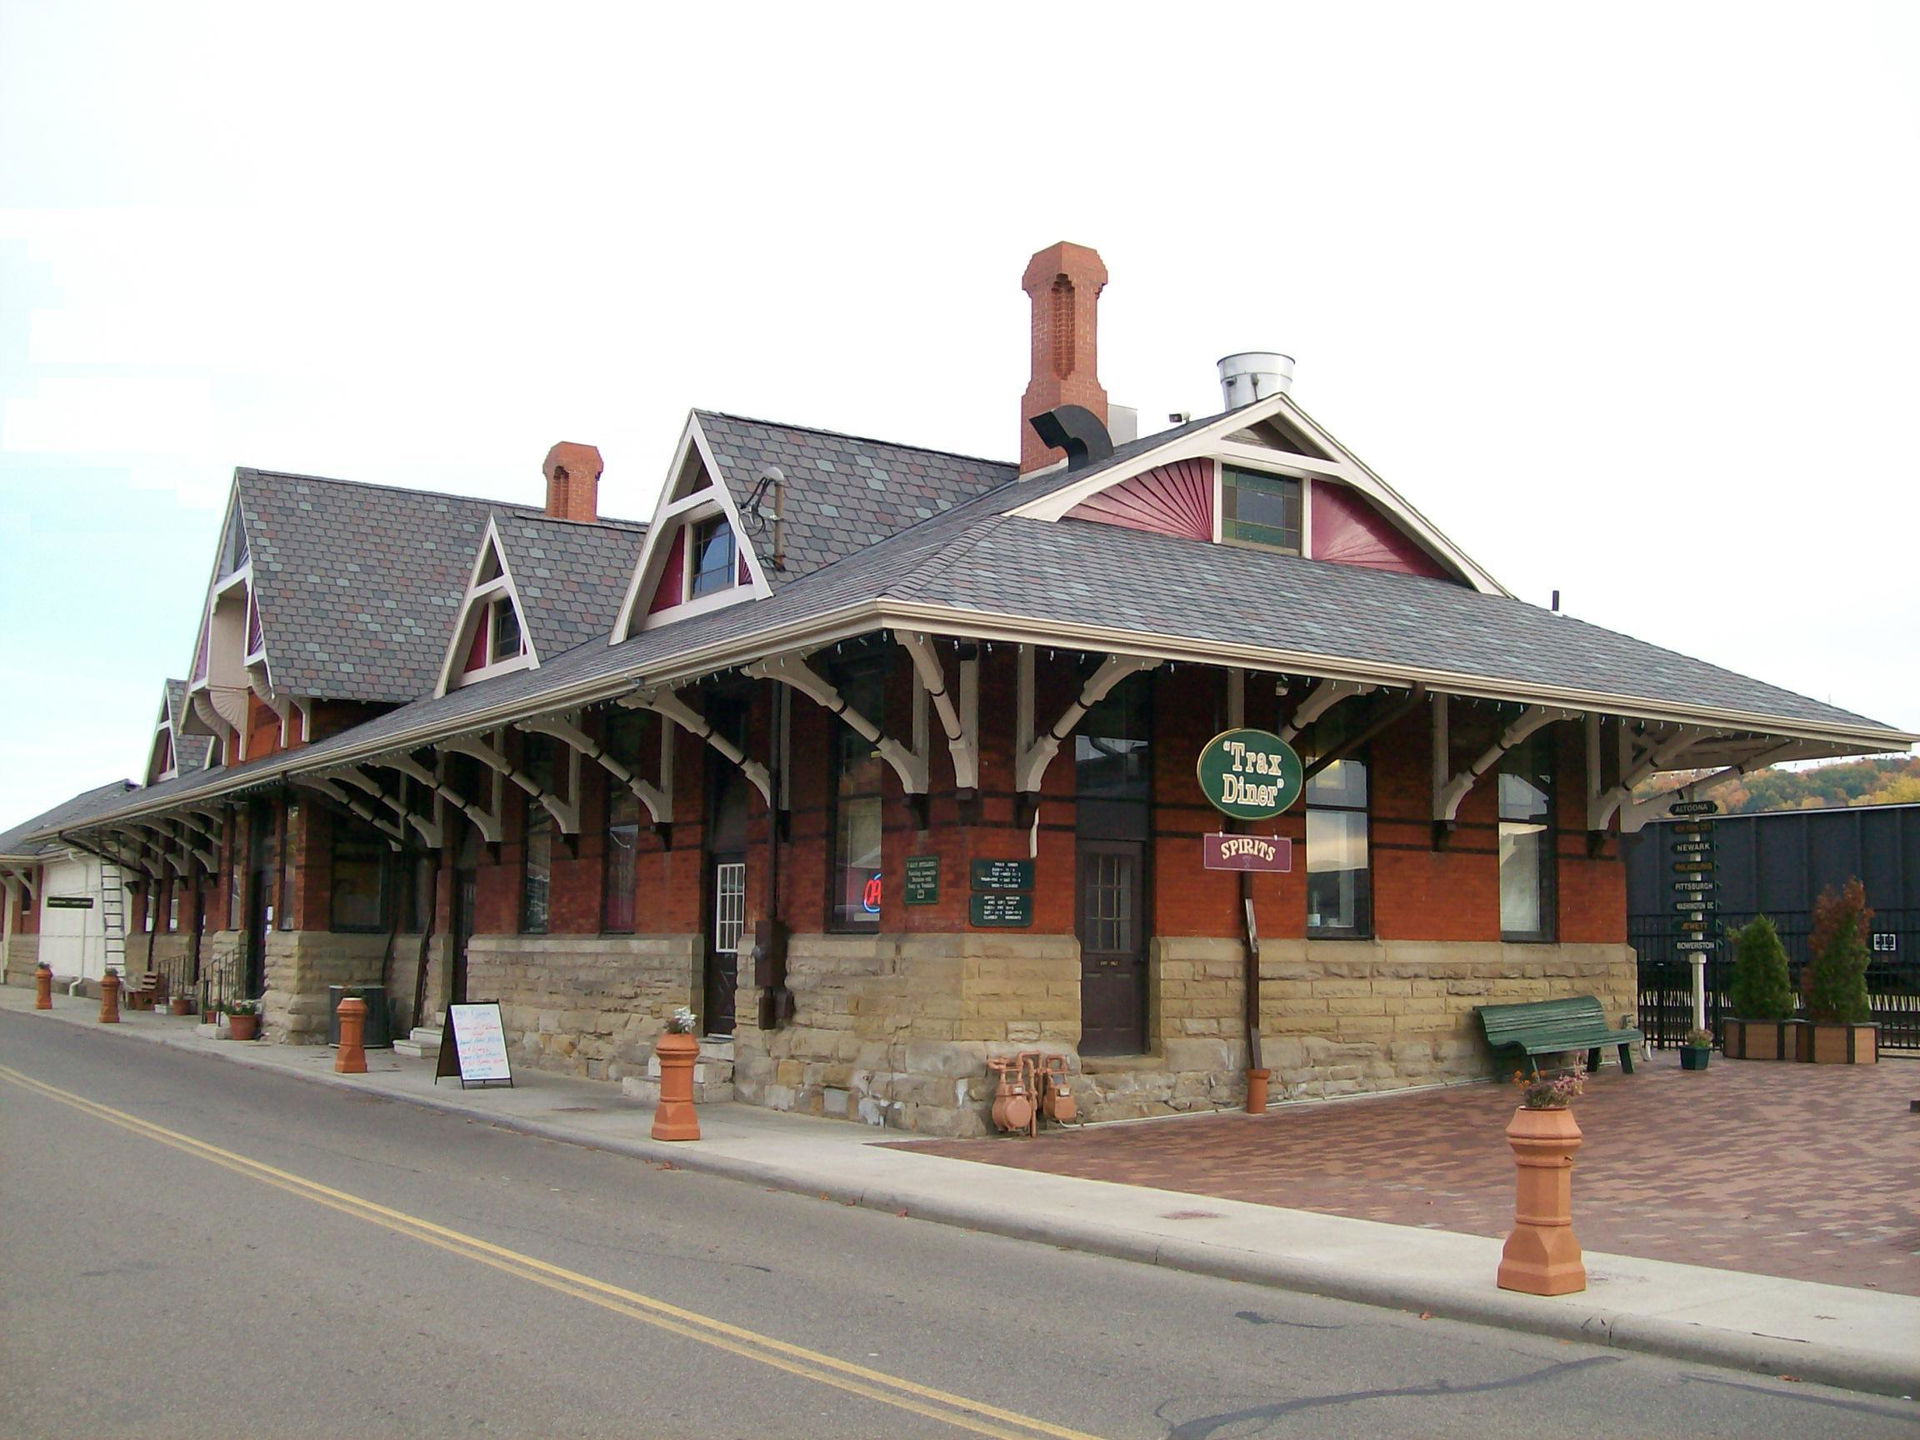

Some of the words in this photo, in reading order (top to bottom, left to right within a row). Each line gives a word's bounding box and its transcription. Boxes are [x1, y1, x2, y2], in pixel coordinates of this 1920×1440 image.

[1222, 740, 1282, 777] "Trax
[1221, 774, 1285, 807] Diner"
[1675, 803, 1709, 813] ALTOONA
[1220, 838, 1277, 862] SPIRITS
[1677, 842, 1711, 852] NEWARK
[1675, 882, 1713, 890] PITTSBURGH
[1676, 941, 1715, 950] BOWERSTON
